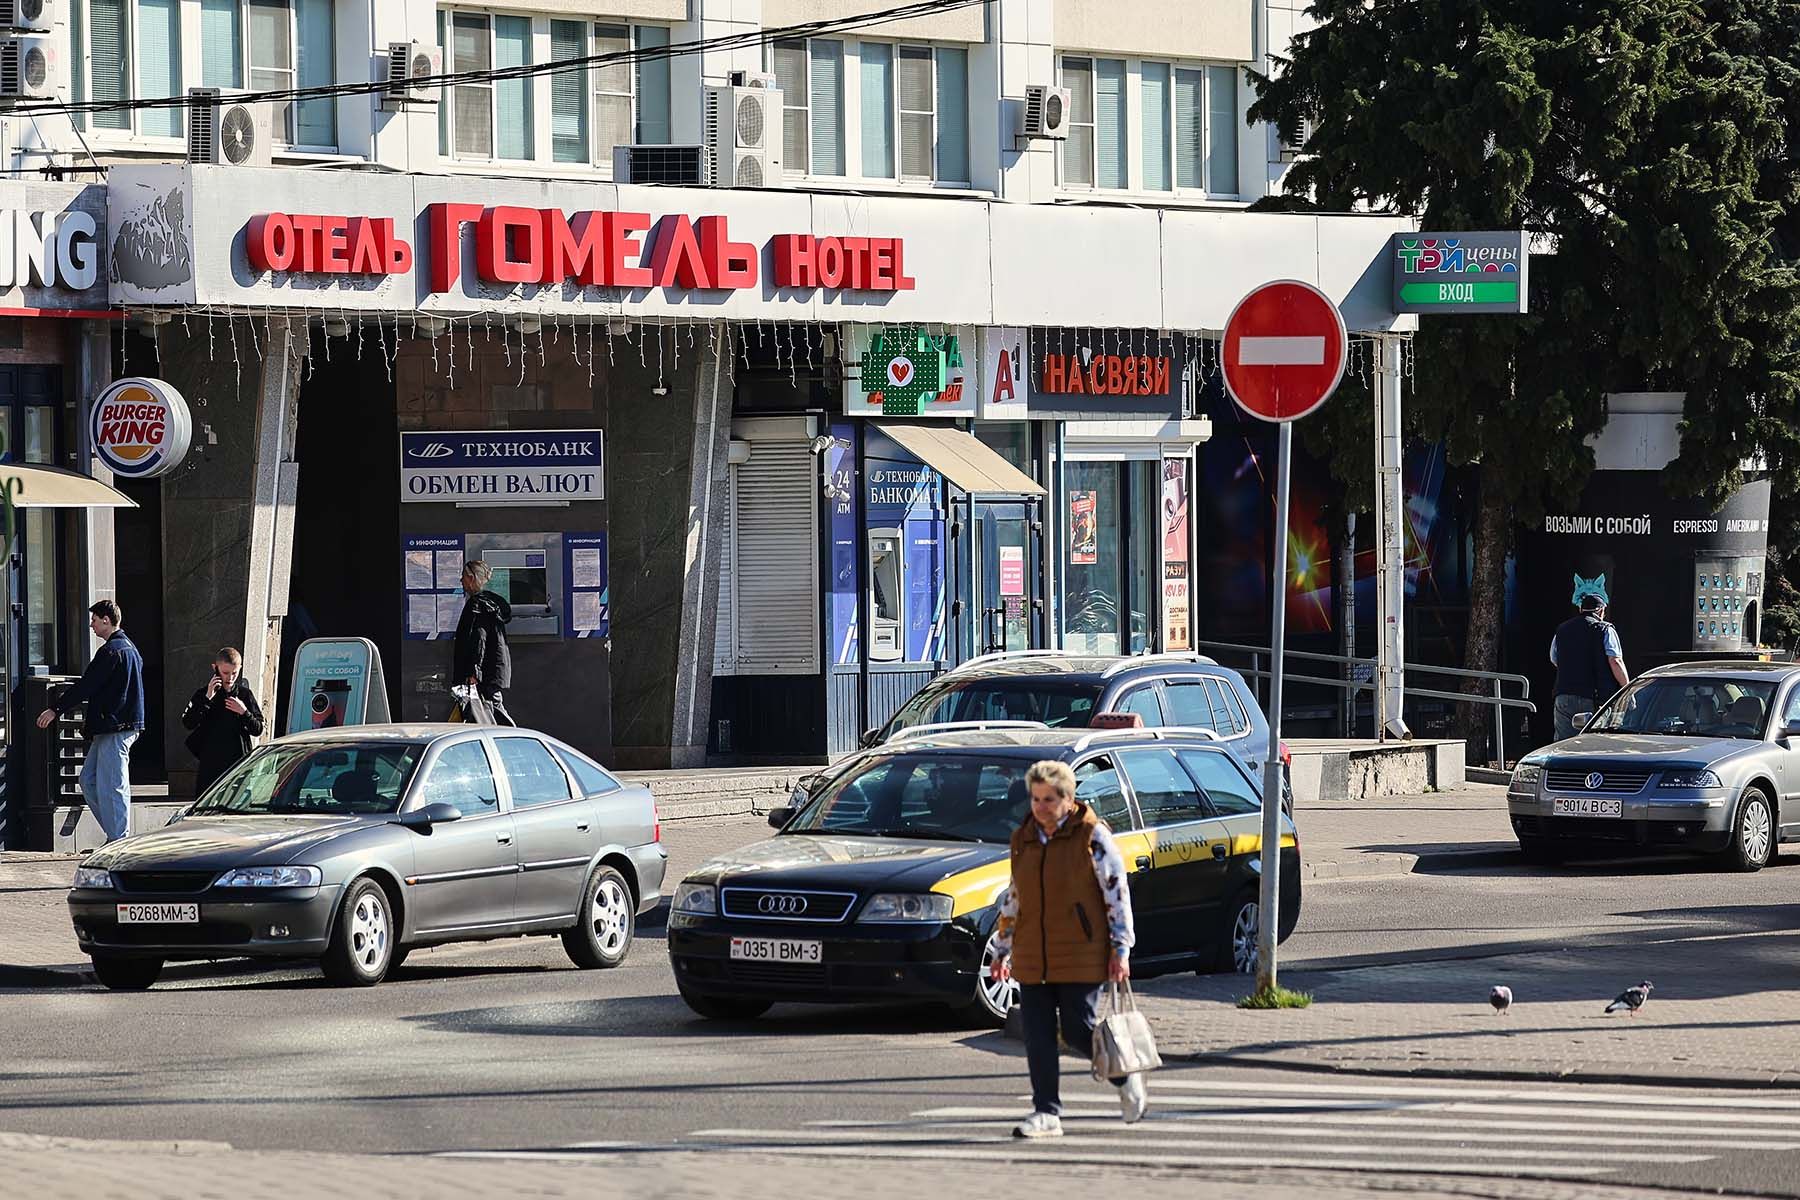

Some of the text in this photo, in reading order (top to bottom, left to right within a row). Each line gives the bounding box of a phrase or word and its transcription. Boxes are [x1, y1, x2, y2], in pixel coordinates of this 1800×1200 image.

[262, 203, 758, 293] ОТЕЛЬ ГОМЕЛЬ
[789, 234, 915, 290] HOTEL
[1397, 247, 1517, 273] ТРИ цены
[1439, 283, 1474, 302] ВХОД
[1050, 353, 1171, 395] НА СВЯЗИ
[101, 404, 166, 422] BURGER
[99, 421, 165, 445] KING
[462, 441, 594, 457] ТЕХНОБАНК
[408, 473, 595, 494] ОБМЕН ВАЛЮТ
[836, 470, 850, 489] 24
[886, 470, 939, 483] ТЕХНОБАНК
[871, 487, 940, 504] БАНКОМАТ
[837, 503, 851, 514] ATM
[1545, 514, 1651, 535] ВОЗЬМИ С СОБОЙ
[1673, 519, 1718, 533] ESPRESSO
[1563, 800, 1588, 812] 9014
[129, 905, 197, 921] 6268MM-3
[743, 941, 775, 958] 0351
